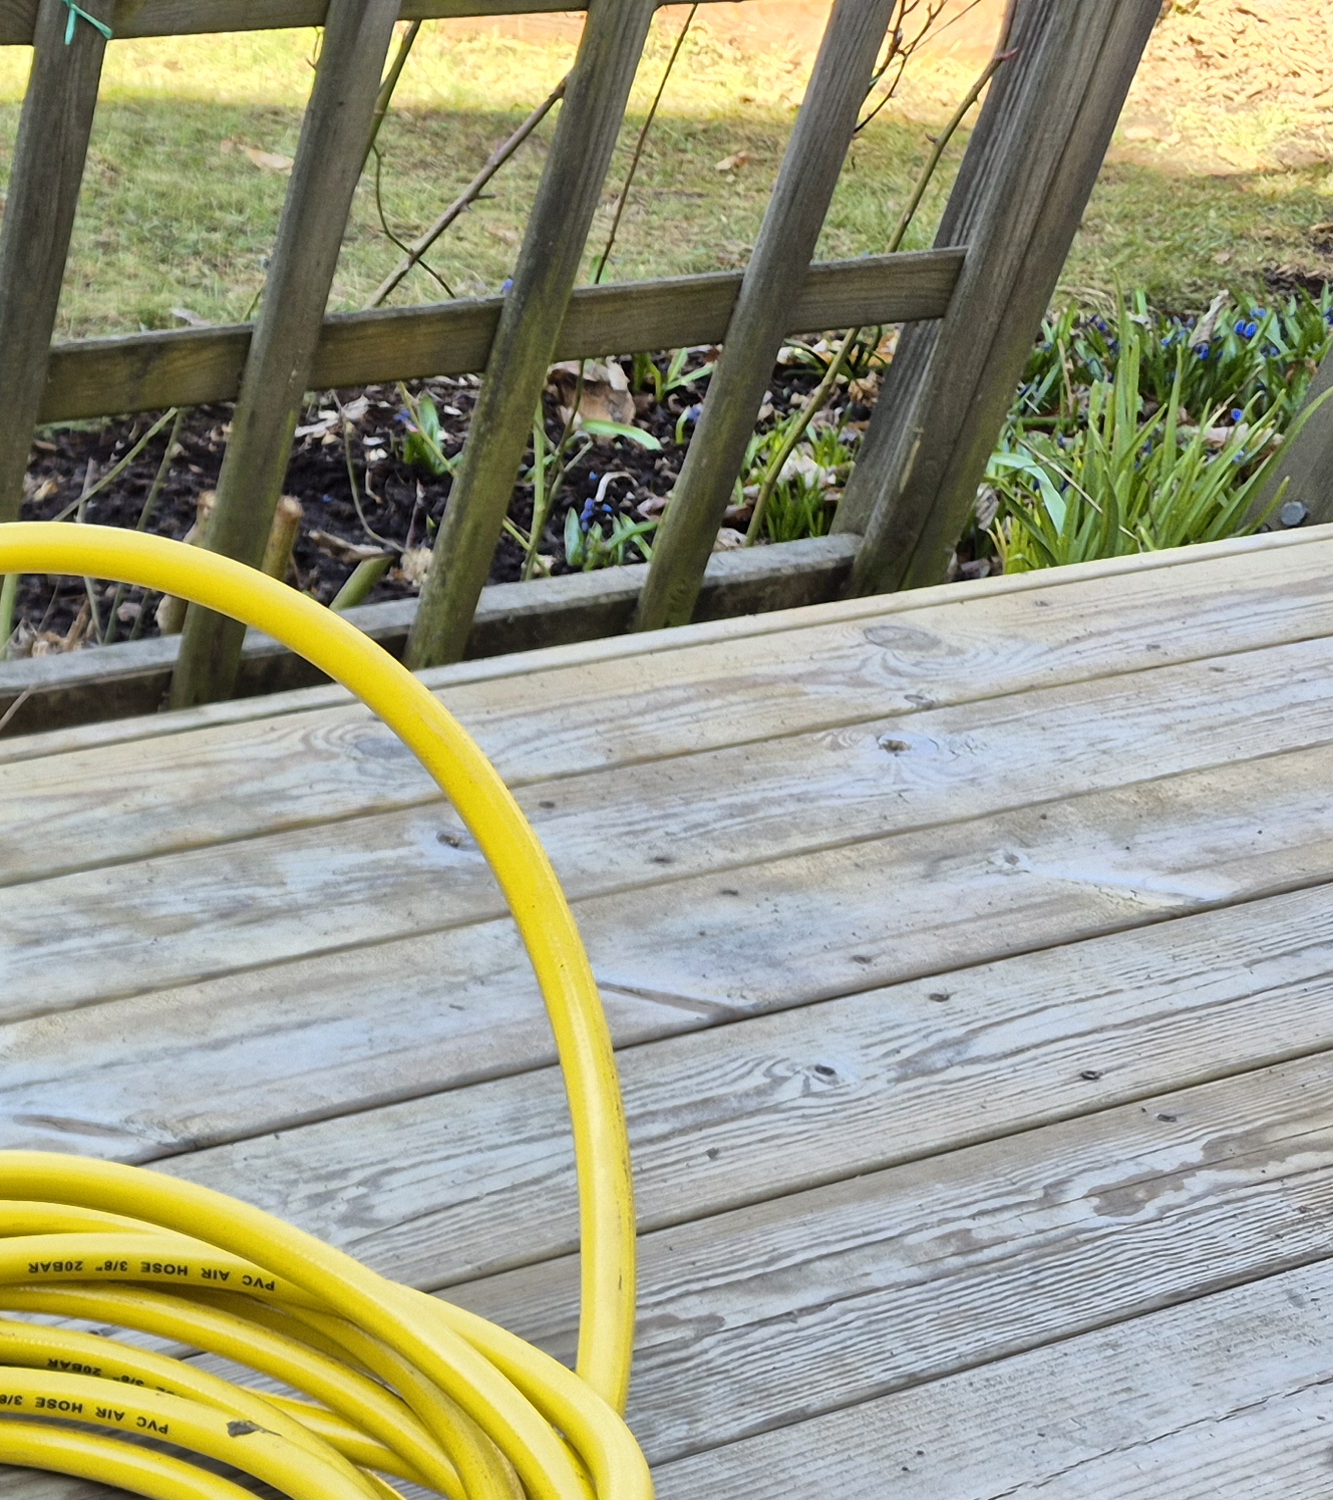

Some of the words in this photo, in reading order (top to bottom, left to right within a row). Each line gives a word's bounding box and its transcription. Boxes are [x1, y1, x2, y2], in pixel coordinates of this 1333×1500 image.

[28, 1260, 83, 1273] 20BAR
[95, 1260, 128, 1272] 3/8"
[140, 1261, 188, 1276] HOSE
[201, 1267, 230, 1281] AIR
[242, 1274, 275, 1291] PVC
[47, 1358, 102, 1376] 20BAR
[35, 1396, 83, 1413] HOSE
[95, 1406, 125, 1421] AIR
[136, 1416, 169, 1434] PVC
